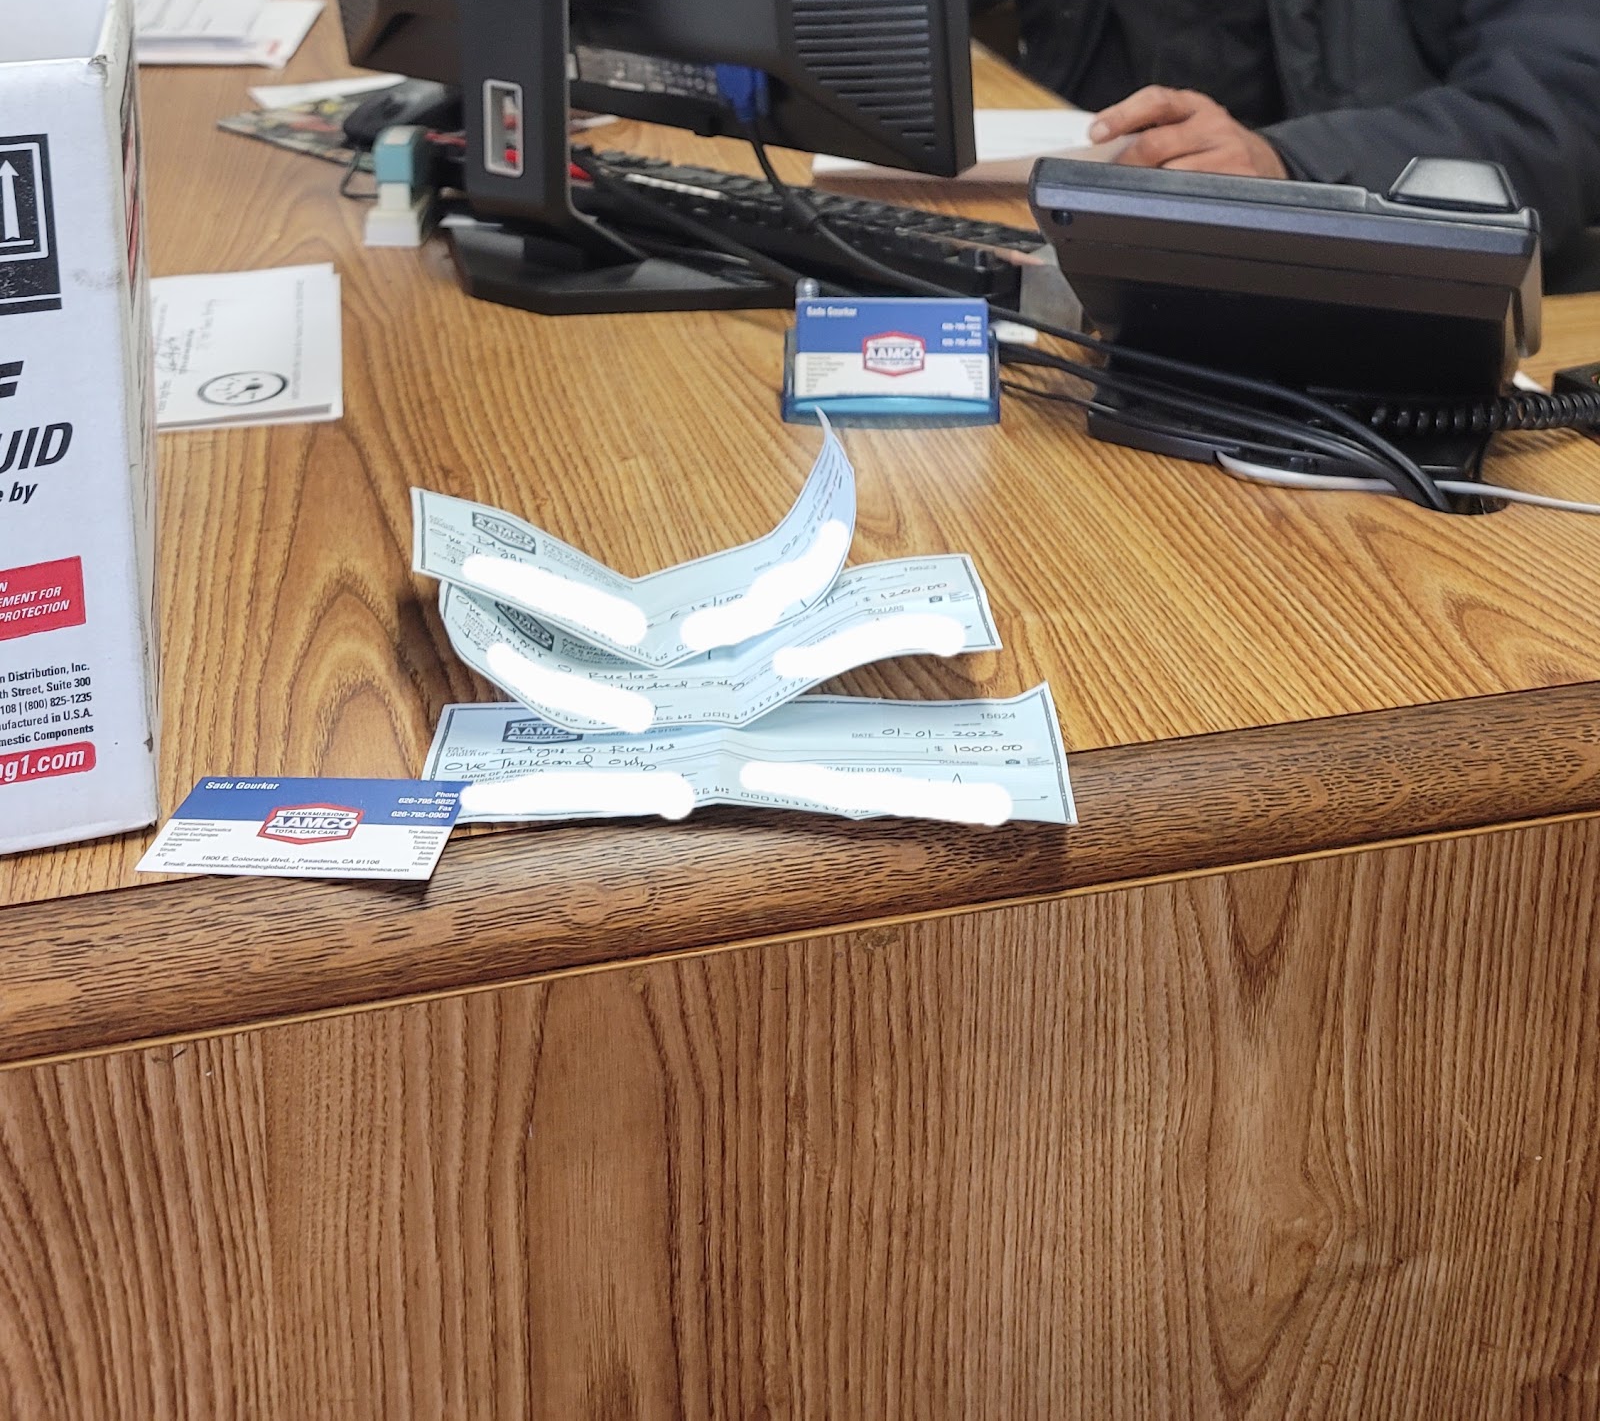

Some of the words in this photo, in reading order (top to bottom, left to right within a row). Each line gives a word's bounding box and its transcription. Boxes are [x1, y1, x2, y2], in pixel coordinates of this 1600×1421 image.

[866, 347, 924, 359] AAMCO
[9, 481, 38, 504] by
[39, 586, 62, 600] FOR
[0, 600, 70, 623] PROTECTION
[8, 665, 69, 683] Distribution,
[71, 663, 90, 672] Inc.
[11, 684, 44, 698] Street,
[46, 680, 72, 692] Suite
[74, 677, 91, 688] 300
[25, 698, 48, 712] (800)
[50, 692, 92, 707] 825-1235
[52, 712, 61, 724] in
[63, 707, 93, 720] U.S.A.
[34, 724, 94, 742] Components
[507, 726, 567, 736] AAMC
[954, 744, 1023, 753] 1000.00
[205, 781, 233, 790] Sadu
[235, 781, 280, 791] Gourkar
[266, 816, 358, 830] AAMCO
